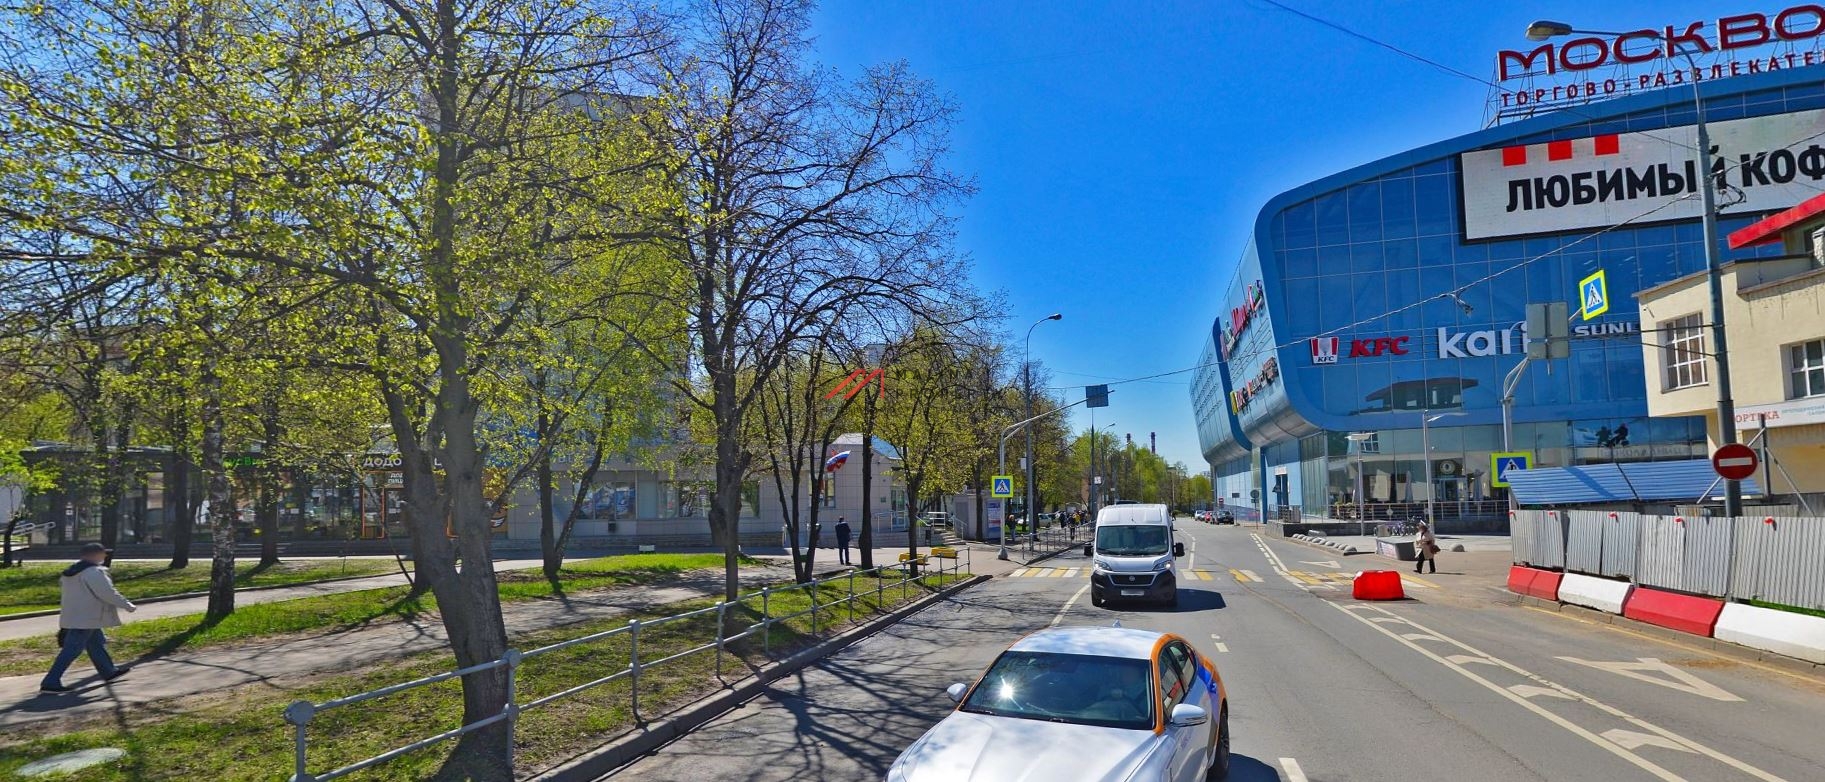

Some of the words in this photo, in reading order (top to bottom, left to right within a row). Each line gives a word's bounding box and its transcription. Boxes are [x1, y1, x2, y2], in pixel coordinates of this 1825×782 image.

[1497, 3, 1825, 82] МОСКВО
[1349, 335, 1409, 358] KFC
[1317, 355, 1335, 363] KFC
